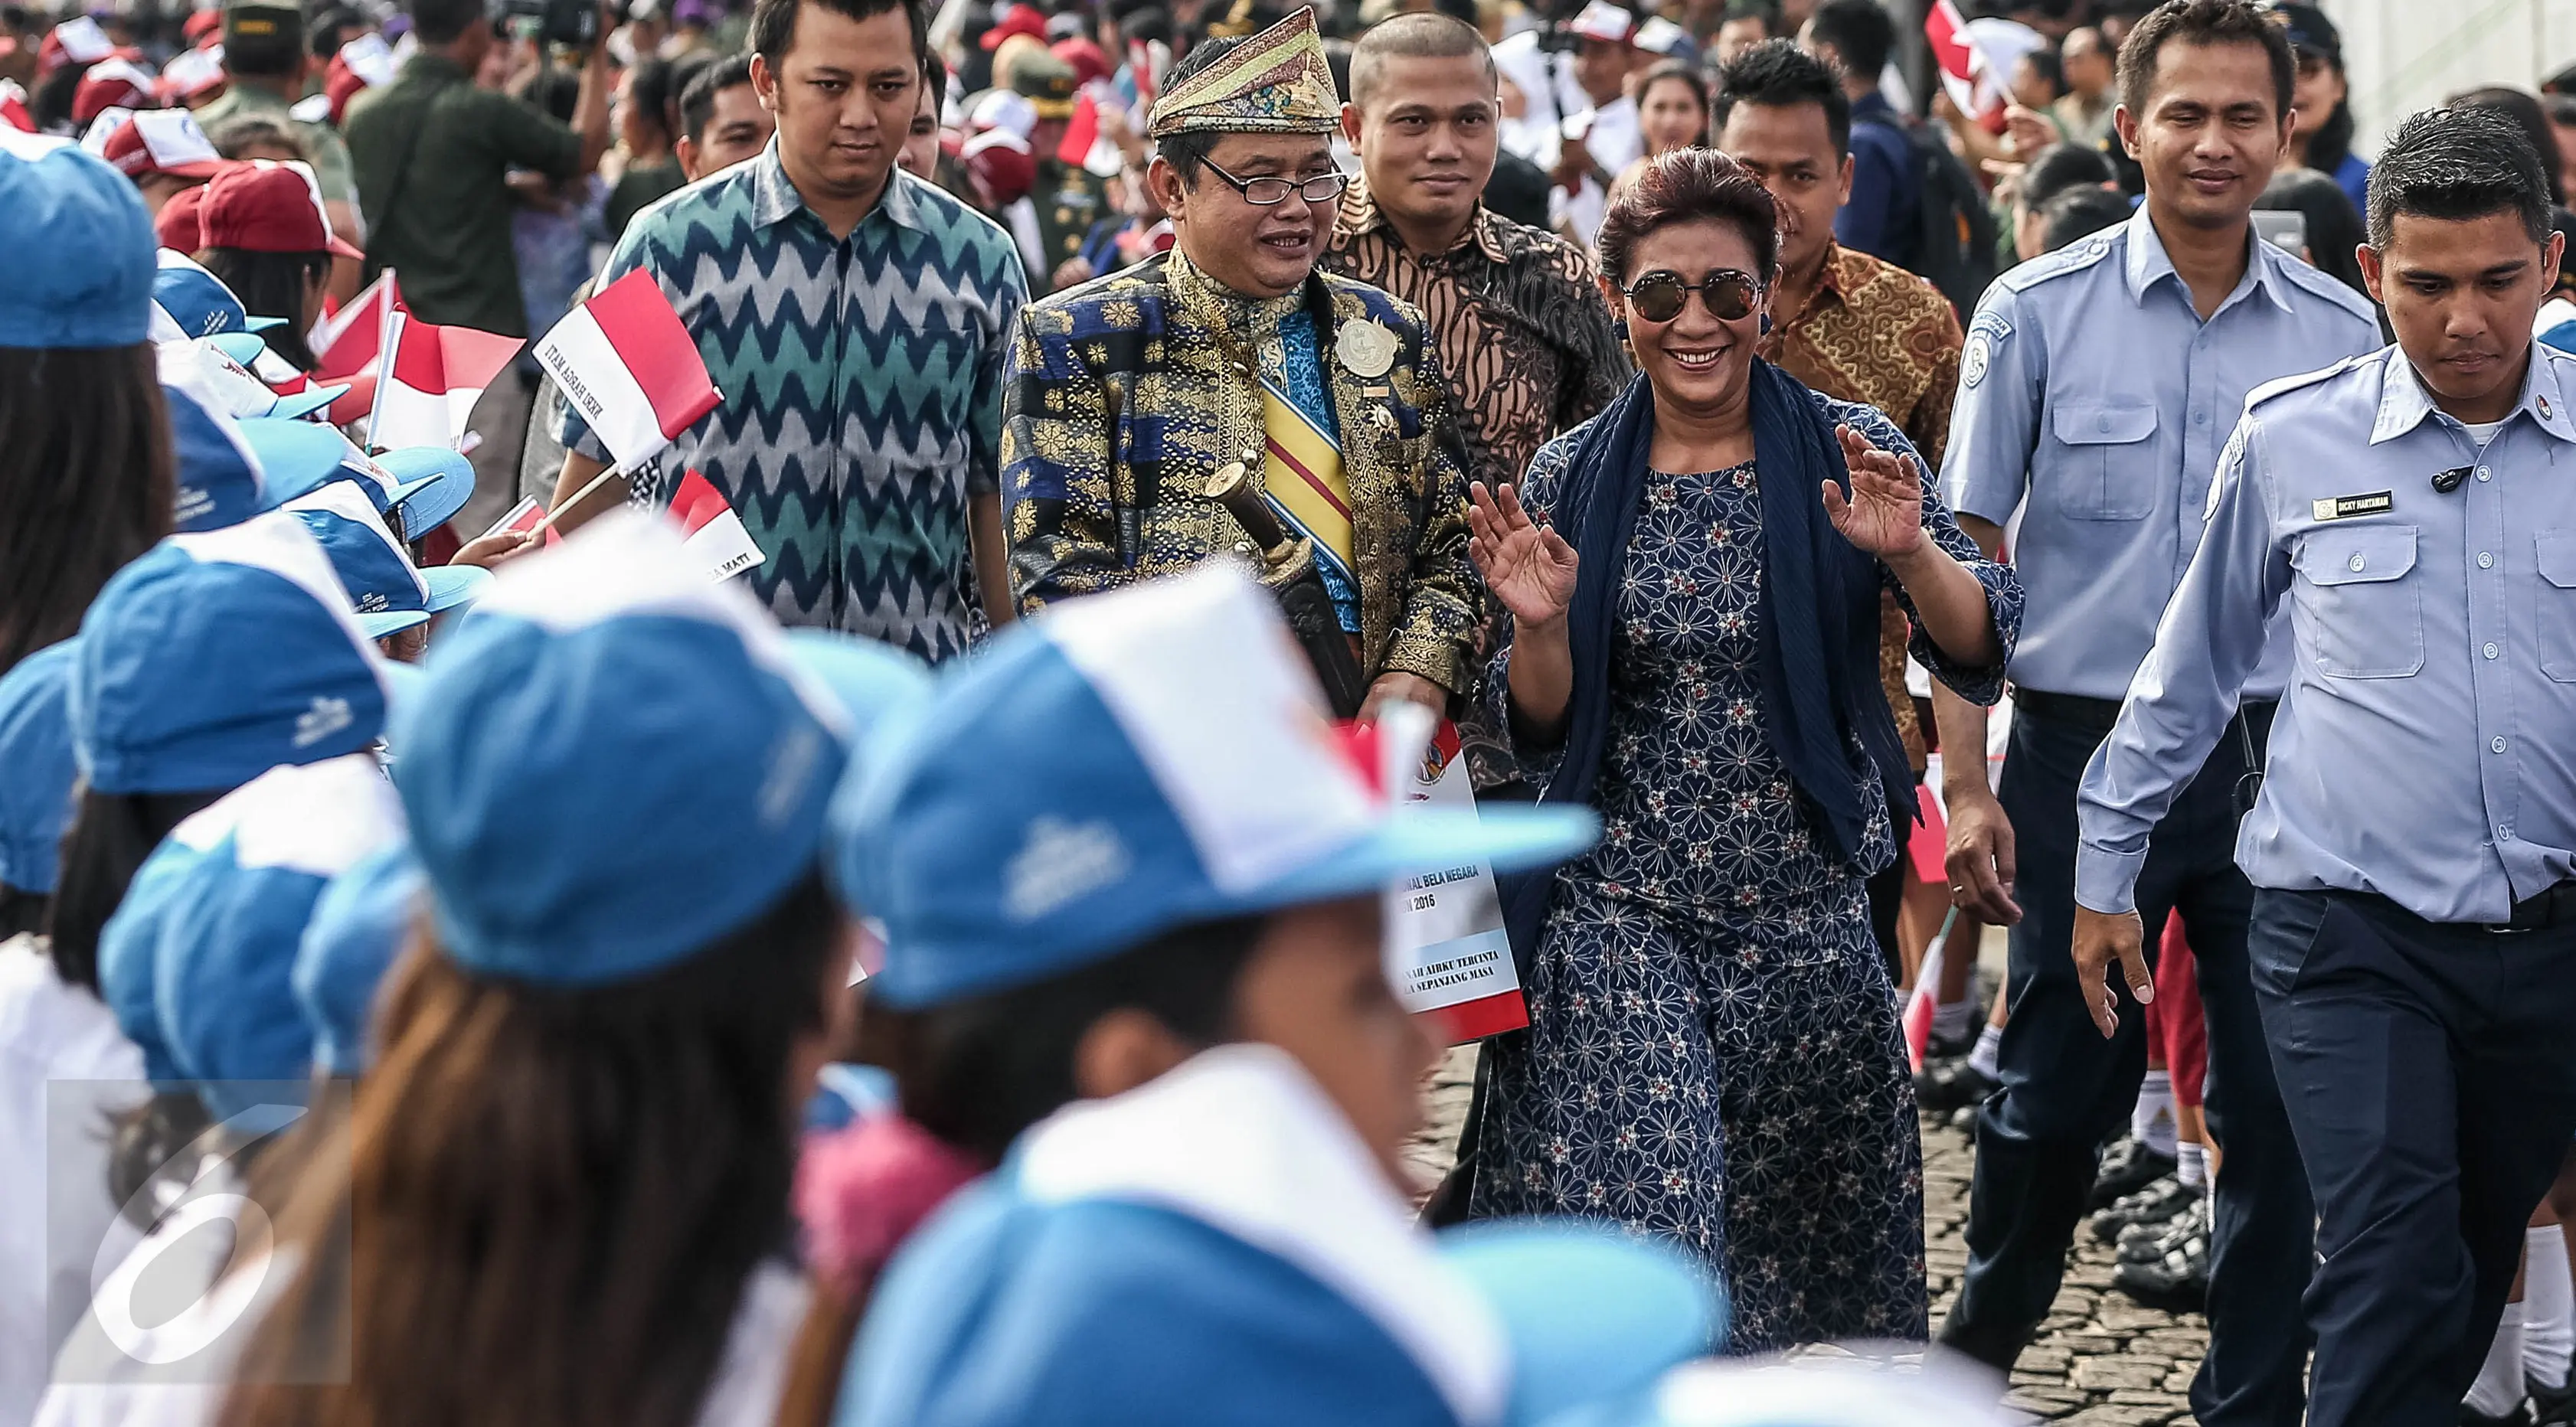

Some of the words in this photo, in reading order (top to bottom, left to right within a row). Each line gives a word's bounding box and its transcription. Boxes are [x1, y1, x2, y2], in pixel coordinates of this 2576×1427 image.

[2338, 500, 2356, 512] DICKY
[721, 551, 750, 573] MATI
[1422, 872, 1447, 888] BELA
[1444, 864, 1479, 883] NEGARA
[1414, 893, 1436, 910] 2016
[1425, 959, 1455, 976] AIRKU
[1456, 949, 1499, 968] TERCINTA
[1416, 971, 1468, 992] SEPANJANG
[1469, 965, 1494, 980] MASA
